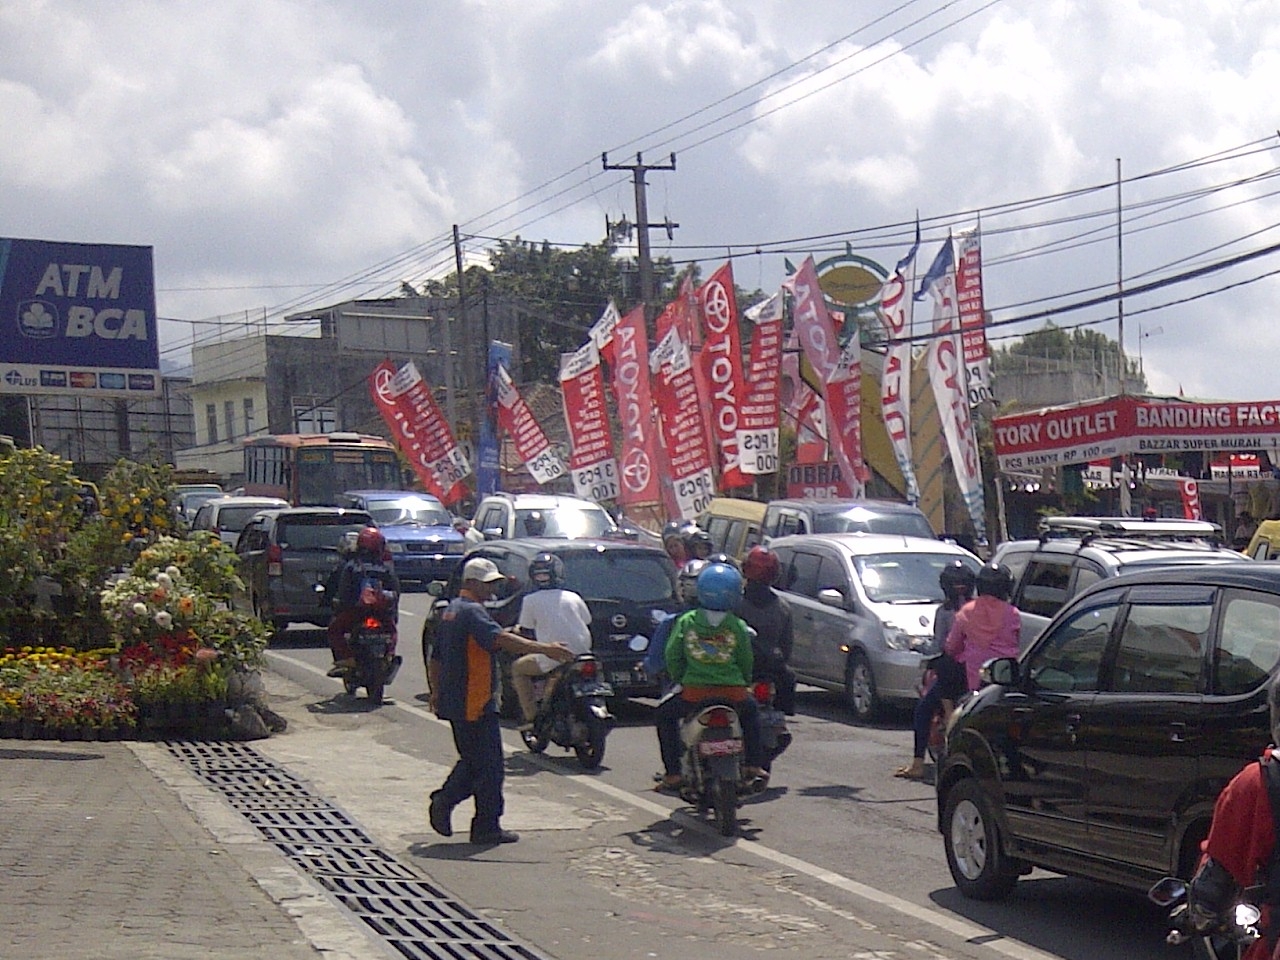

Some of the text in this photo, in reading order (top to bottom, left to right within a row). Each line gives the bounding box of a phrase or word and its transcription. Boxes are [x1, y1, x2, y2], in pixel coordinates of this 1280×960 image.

[35, 263, 124, 299] ATM
[65, 305, 148, 341] BCA
[996, 410, 1118, 447] TORY OUTLET
[1136, 407, 1231, 428] BANDUNG
[1183, 439, 1218, 449] SUPER
[1221, 438, 1261, 448] MURAH
